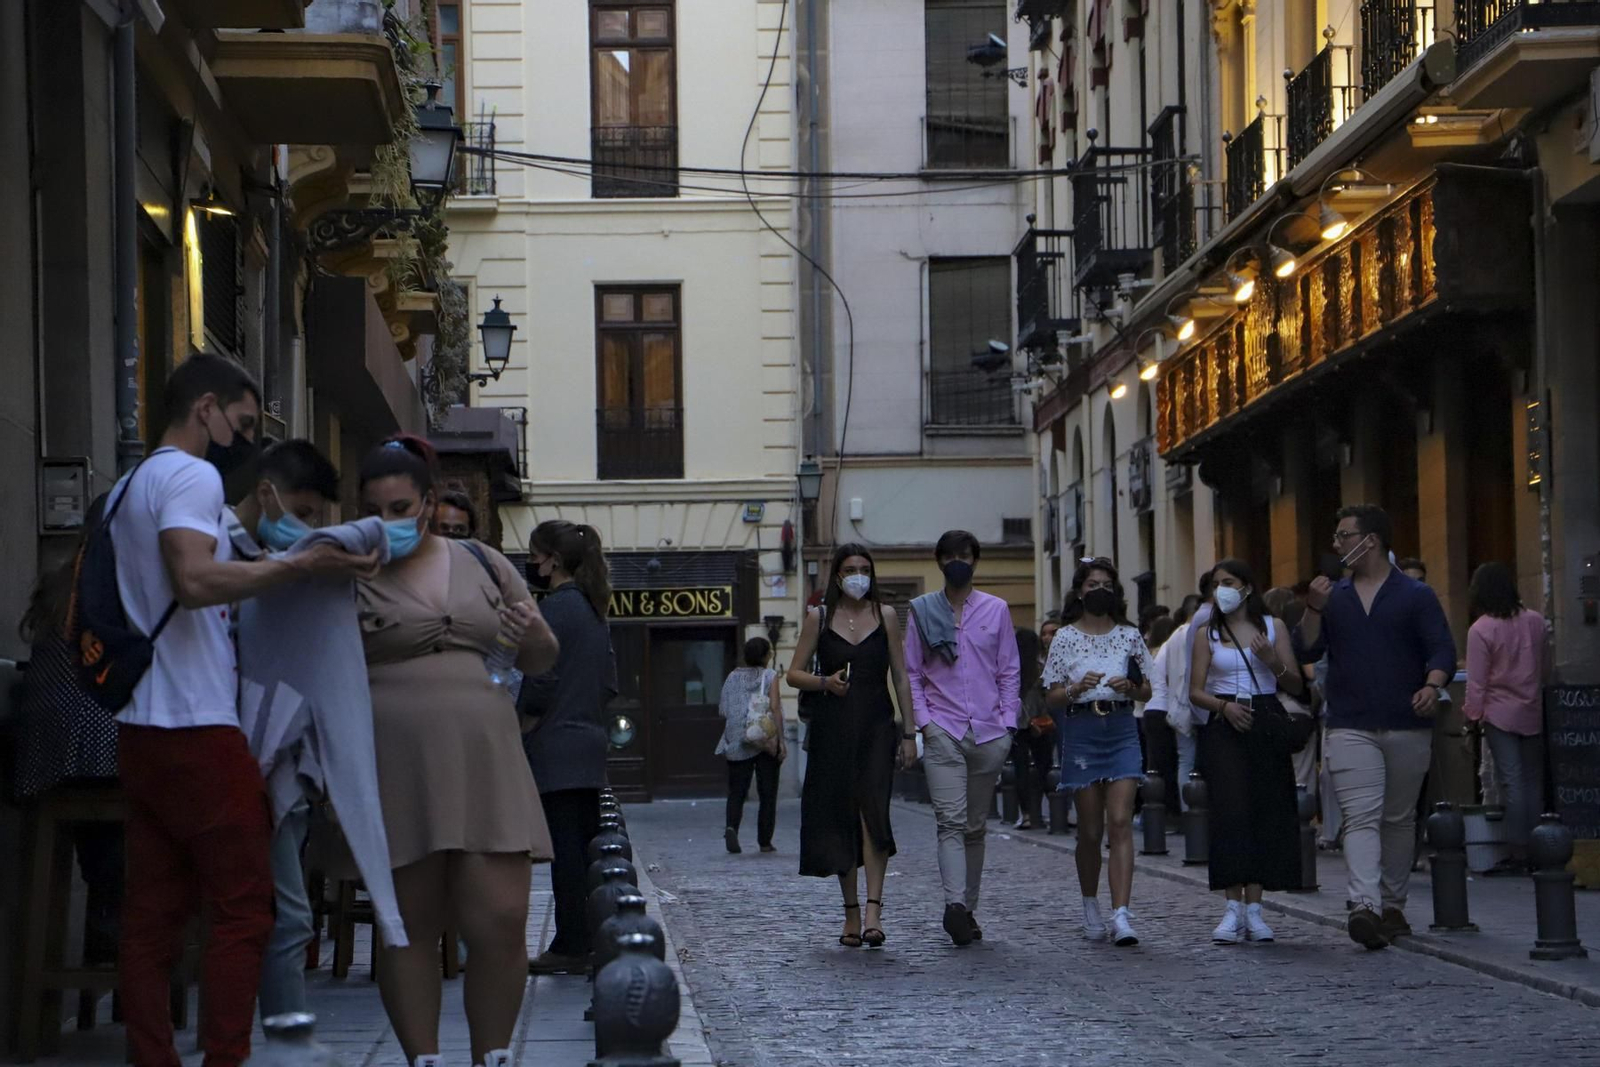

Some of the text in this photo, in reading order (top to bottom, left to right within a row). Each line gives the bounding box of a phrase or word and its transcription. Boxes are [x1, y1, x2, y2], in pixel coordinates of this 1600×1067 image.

[607, 590, 722, 615] AN & SONS
